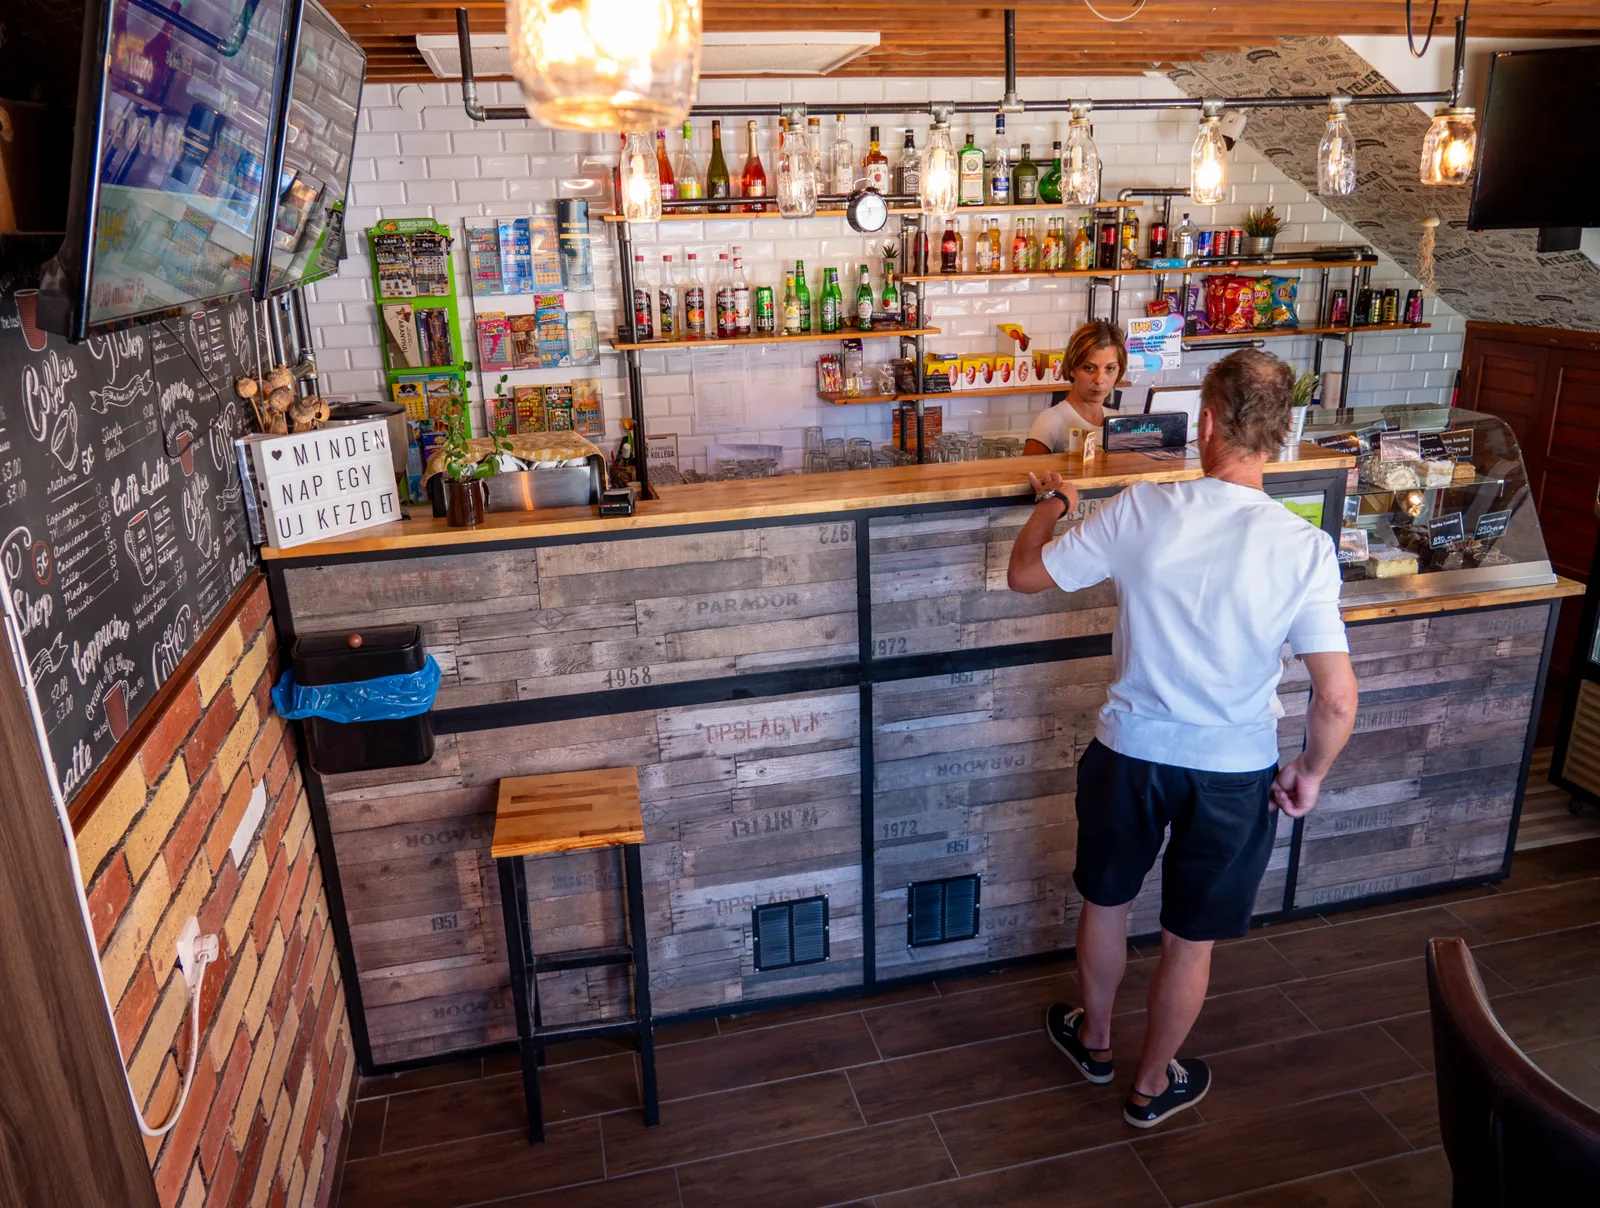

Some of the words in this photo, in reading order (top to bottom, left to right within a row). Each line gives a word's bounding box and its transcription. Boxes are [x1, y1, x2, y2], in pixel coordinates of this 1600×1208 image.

[399, 220, 433, 228] SORSJEGY
[1537, 252, 1590, 267] ATELIER
[22, 349, 78, 443] Coffee
[293, 428, 386, 467] MINDEN
[651, 450, 674, 459] KOLLÉGA
[141, 455, 170, 496] Latte
[281, 475, 323, 505] NAP
[337, 465, 371, 491] EGY
[61, 570, 80, 590] Latte
[13, 587, 53, 637] Shop
[697, 591, 800, 615] PARADOR
[872, 637, 907, 657] 1972
[605, 666, 652, 689] 1958
[61, 739, 92, 802] atte
[937, 755, 1025, 777] PARADOR
[882, 819, 918, 838] 1972
[946, 839, 969, 854] 1951
[430, 914, 458, 931] 1951
